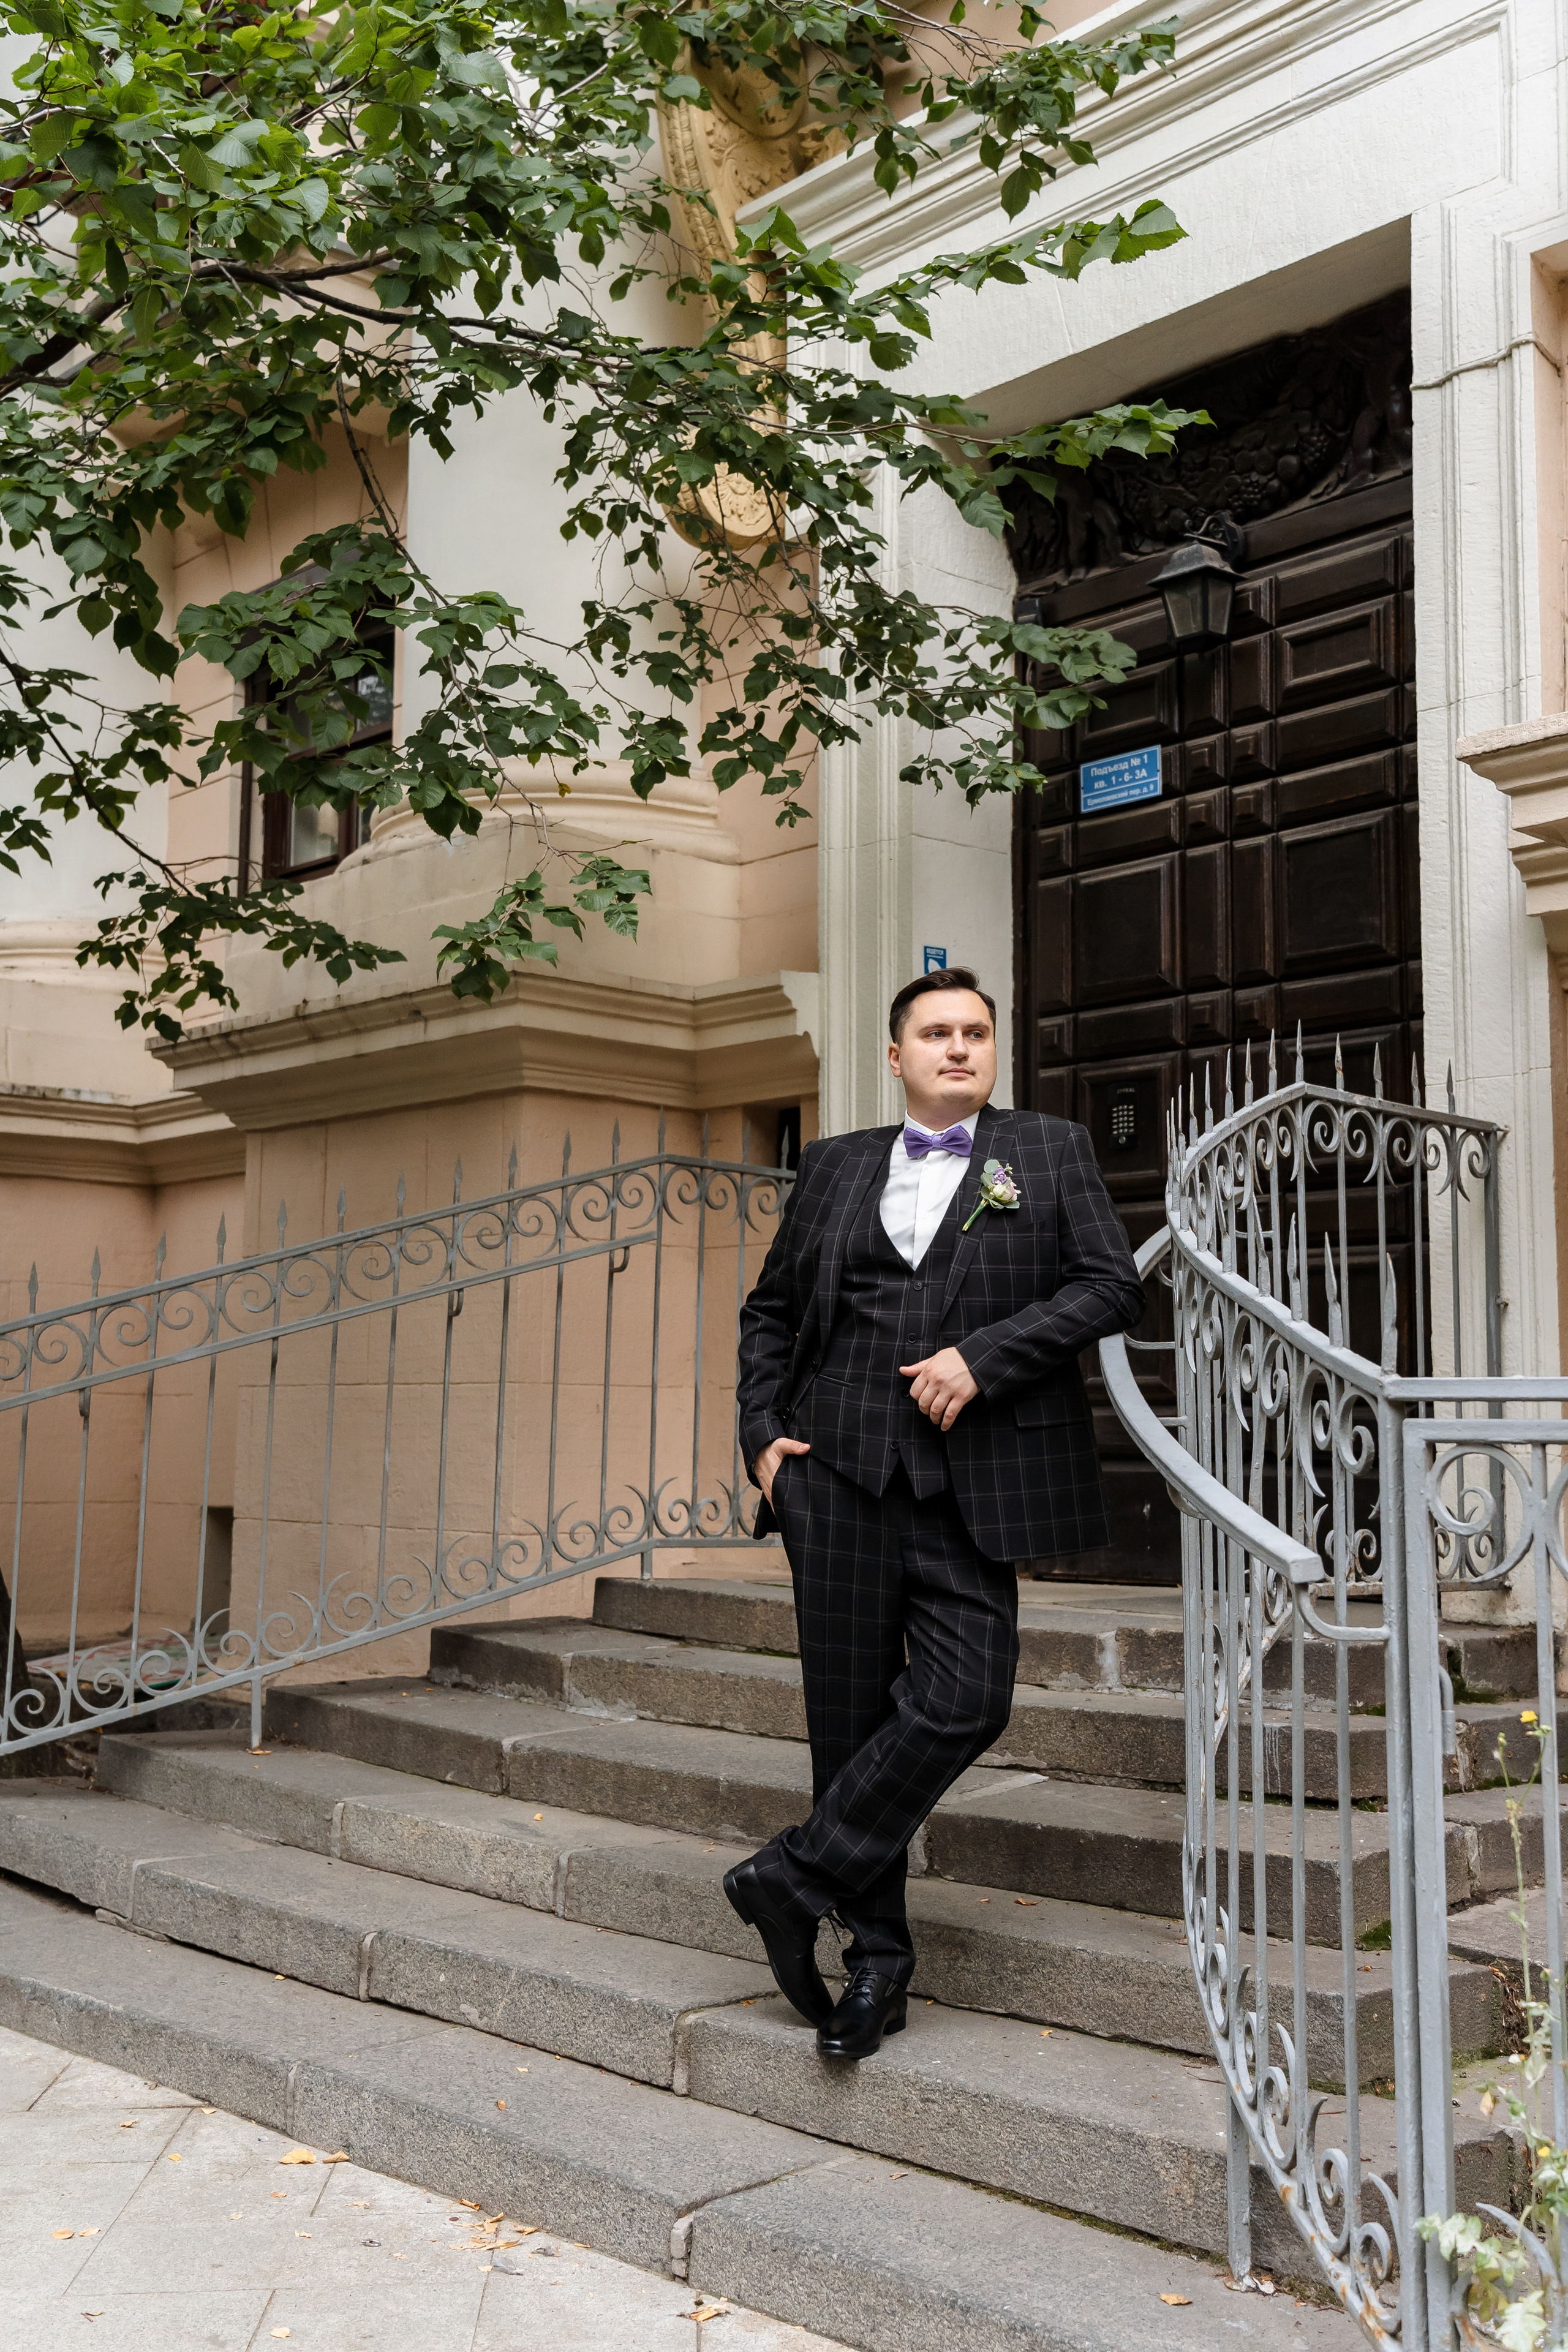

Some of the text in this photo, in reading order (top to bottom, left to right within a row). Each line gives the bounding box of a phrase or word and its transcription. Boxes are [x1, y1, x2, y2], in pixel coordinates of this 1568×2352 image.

[1091, 754, 1148, 777] Подъезд № 1
[1094, 780, 1107, 790] кв.
[1111, 775, 1116, 785] 1
